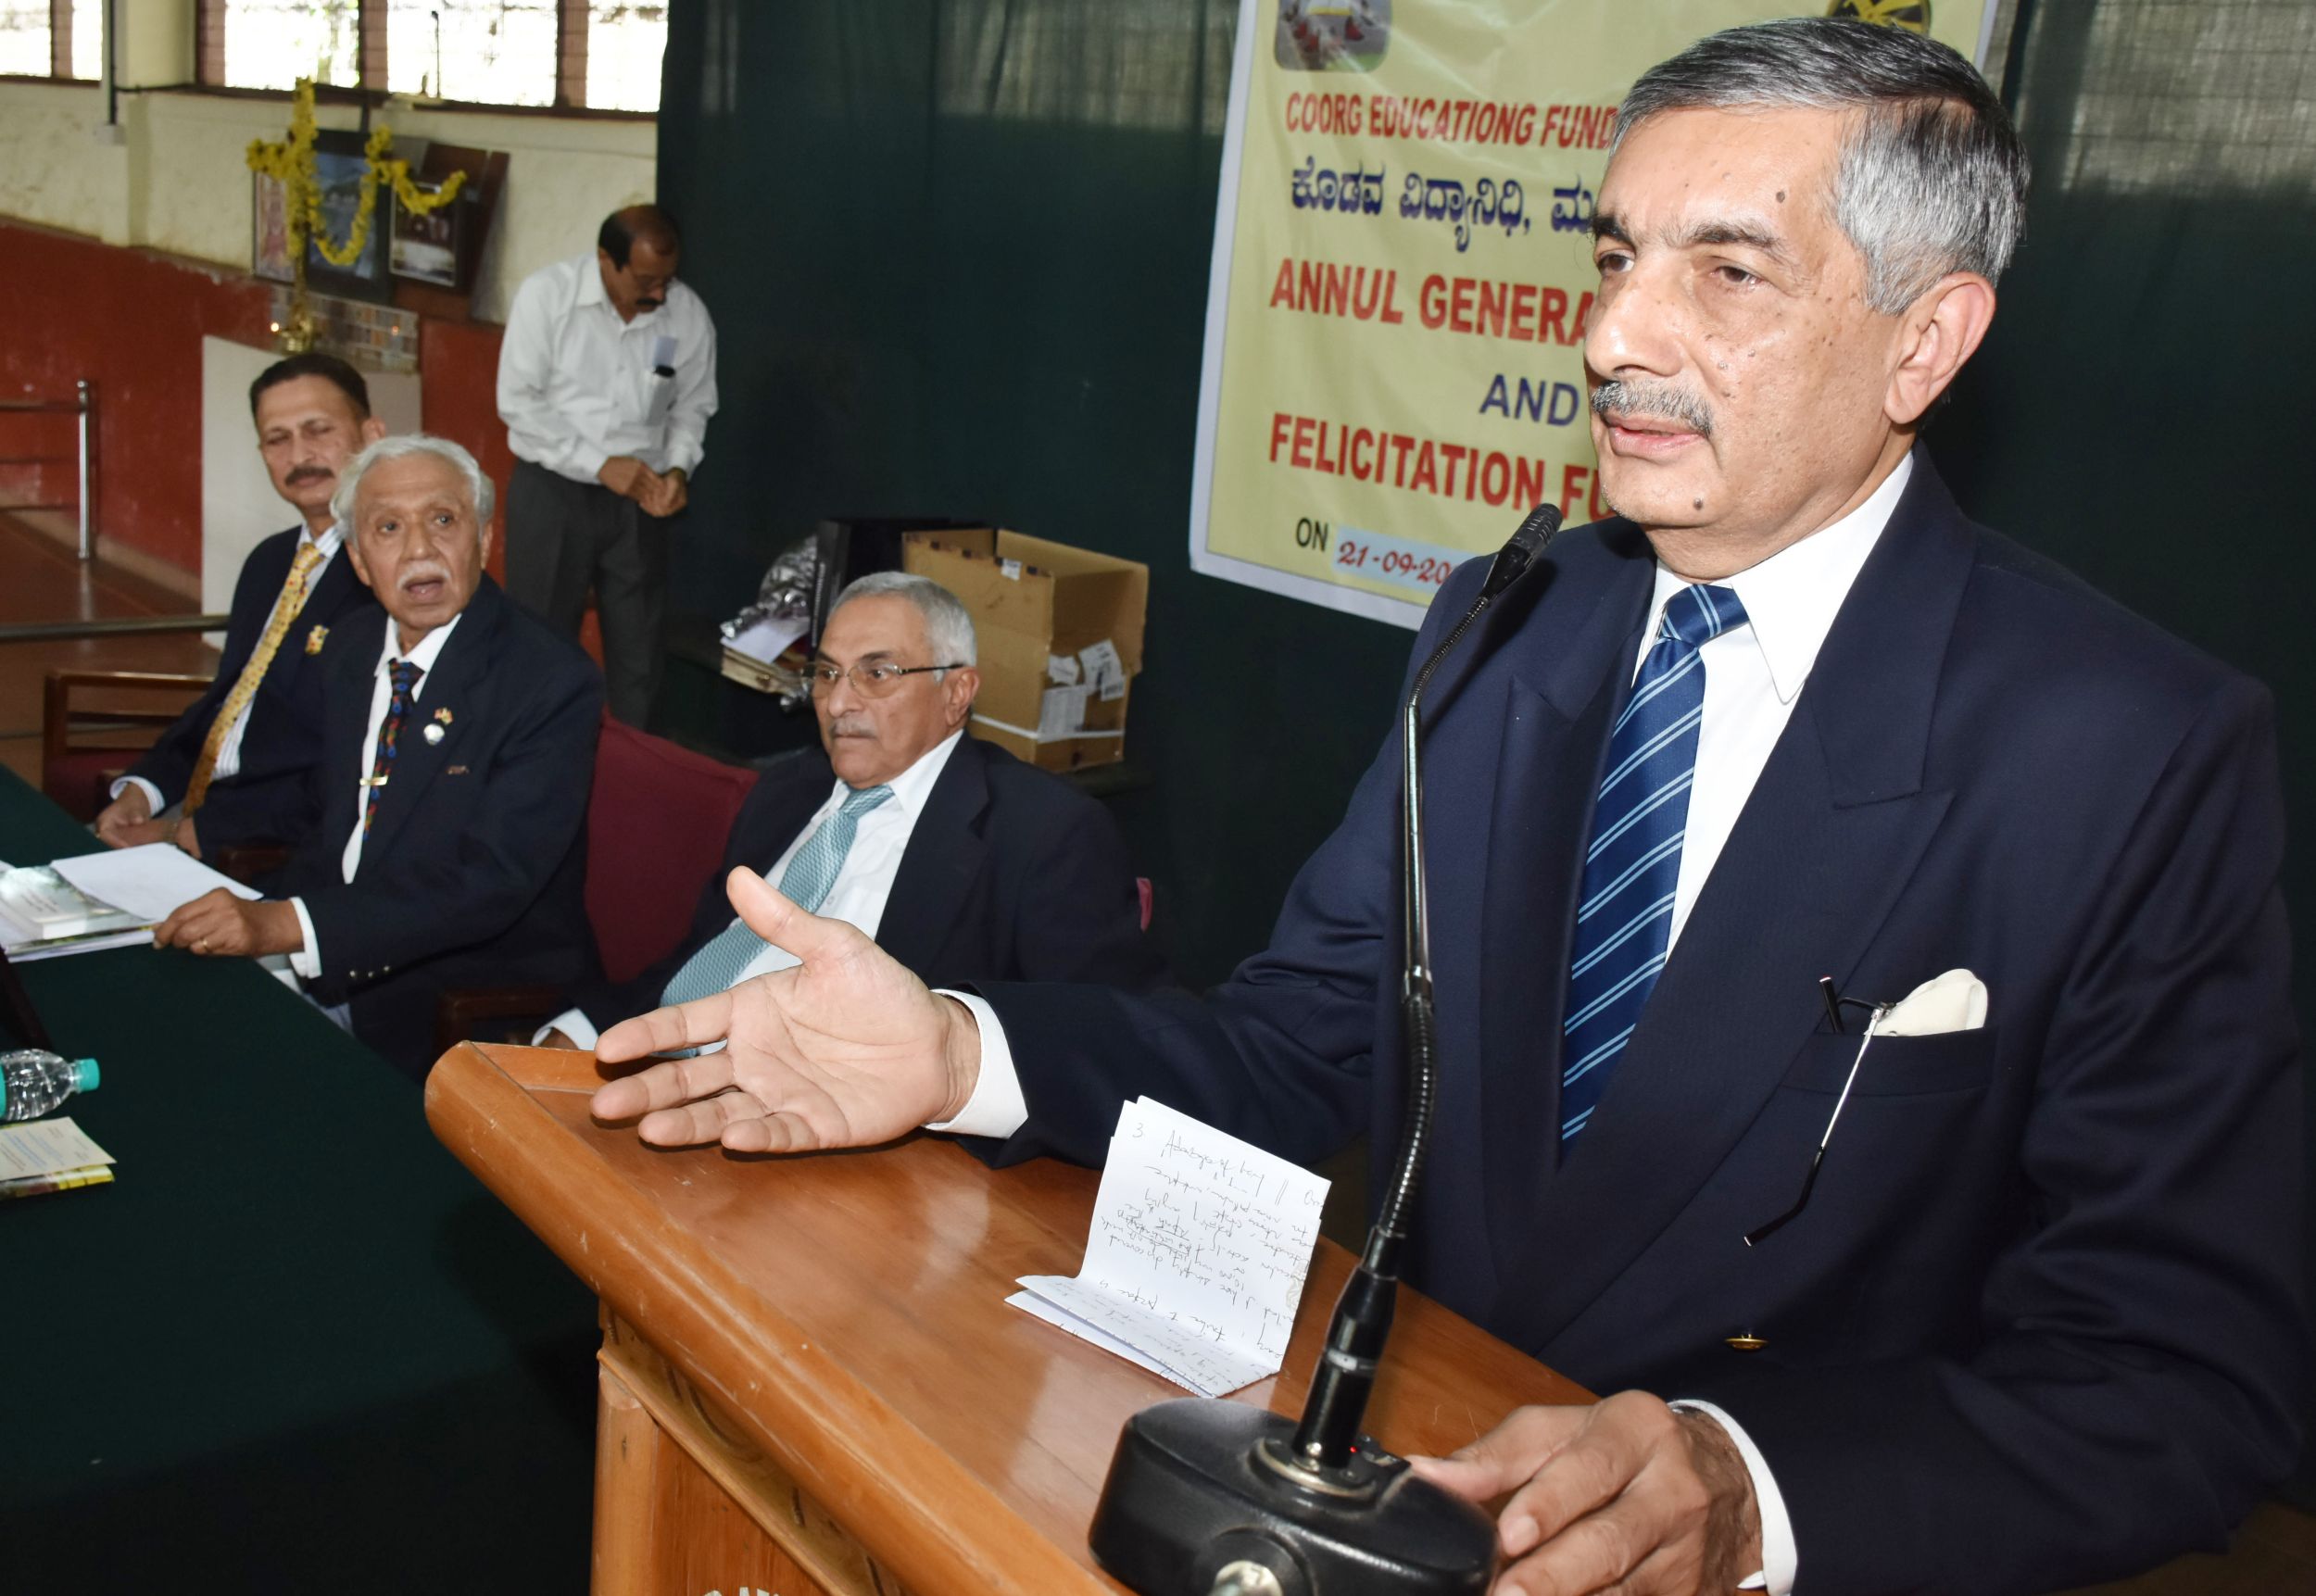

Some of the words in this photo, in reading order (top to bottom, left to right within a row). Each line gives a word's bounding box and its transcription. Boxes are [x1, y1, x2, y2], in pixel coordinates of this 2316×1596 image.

[1286, 91, 1362, 136] COORG
[1368, 95, 1537, 146] EDUCATIONG
[1291, 156, 1386, 215] ಕೊಡವ
[1269, 258, 1403, 325] ANNUL
[1419, 273, 1594, 347] GENERA
[1479, 373, 1580, 427] AND
[1269, 411, 1545, 511] FELICITATION
[1296, 517, 1328, 551] ON
[1337, 540, 1452, 585] 21-09-20
